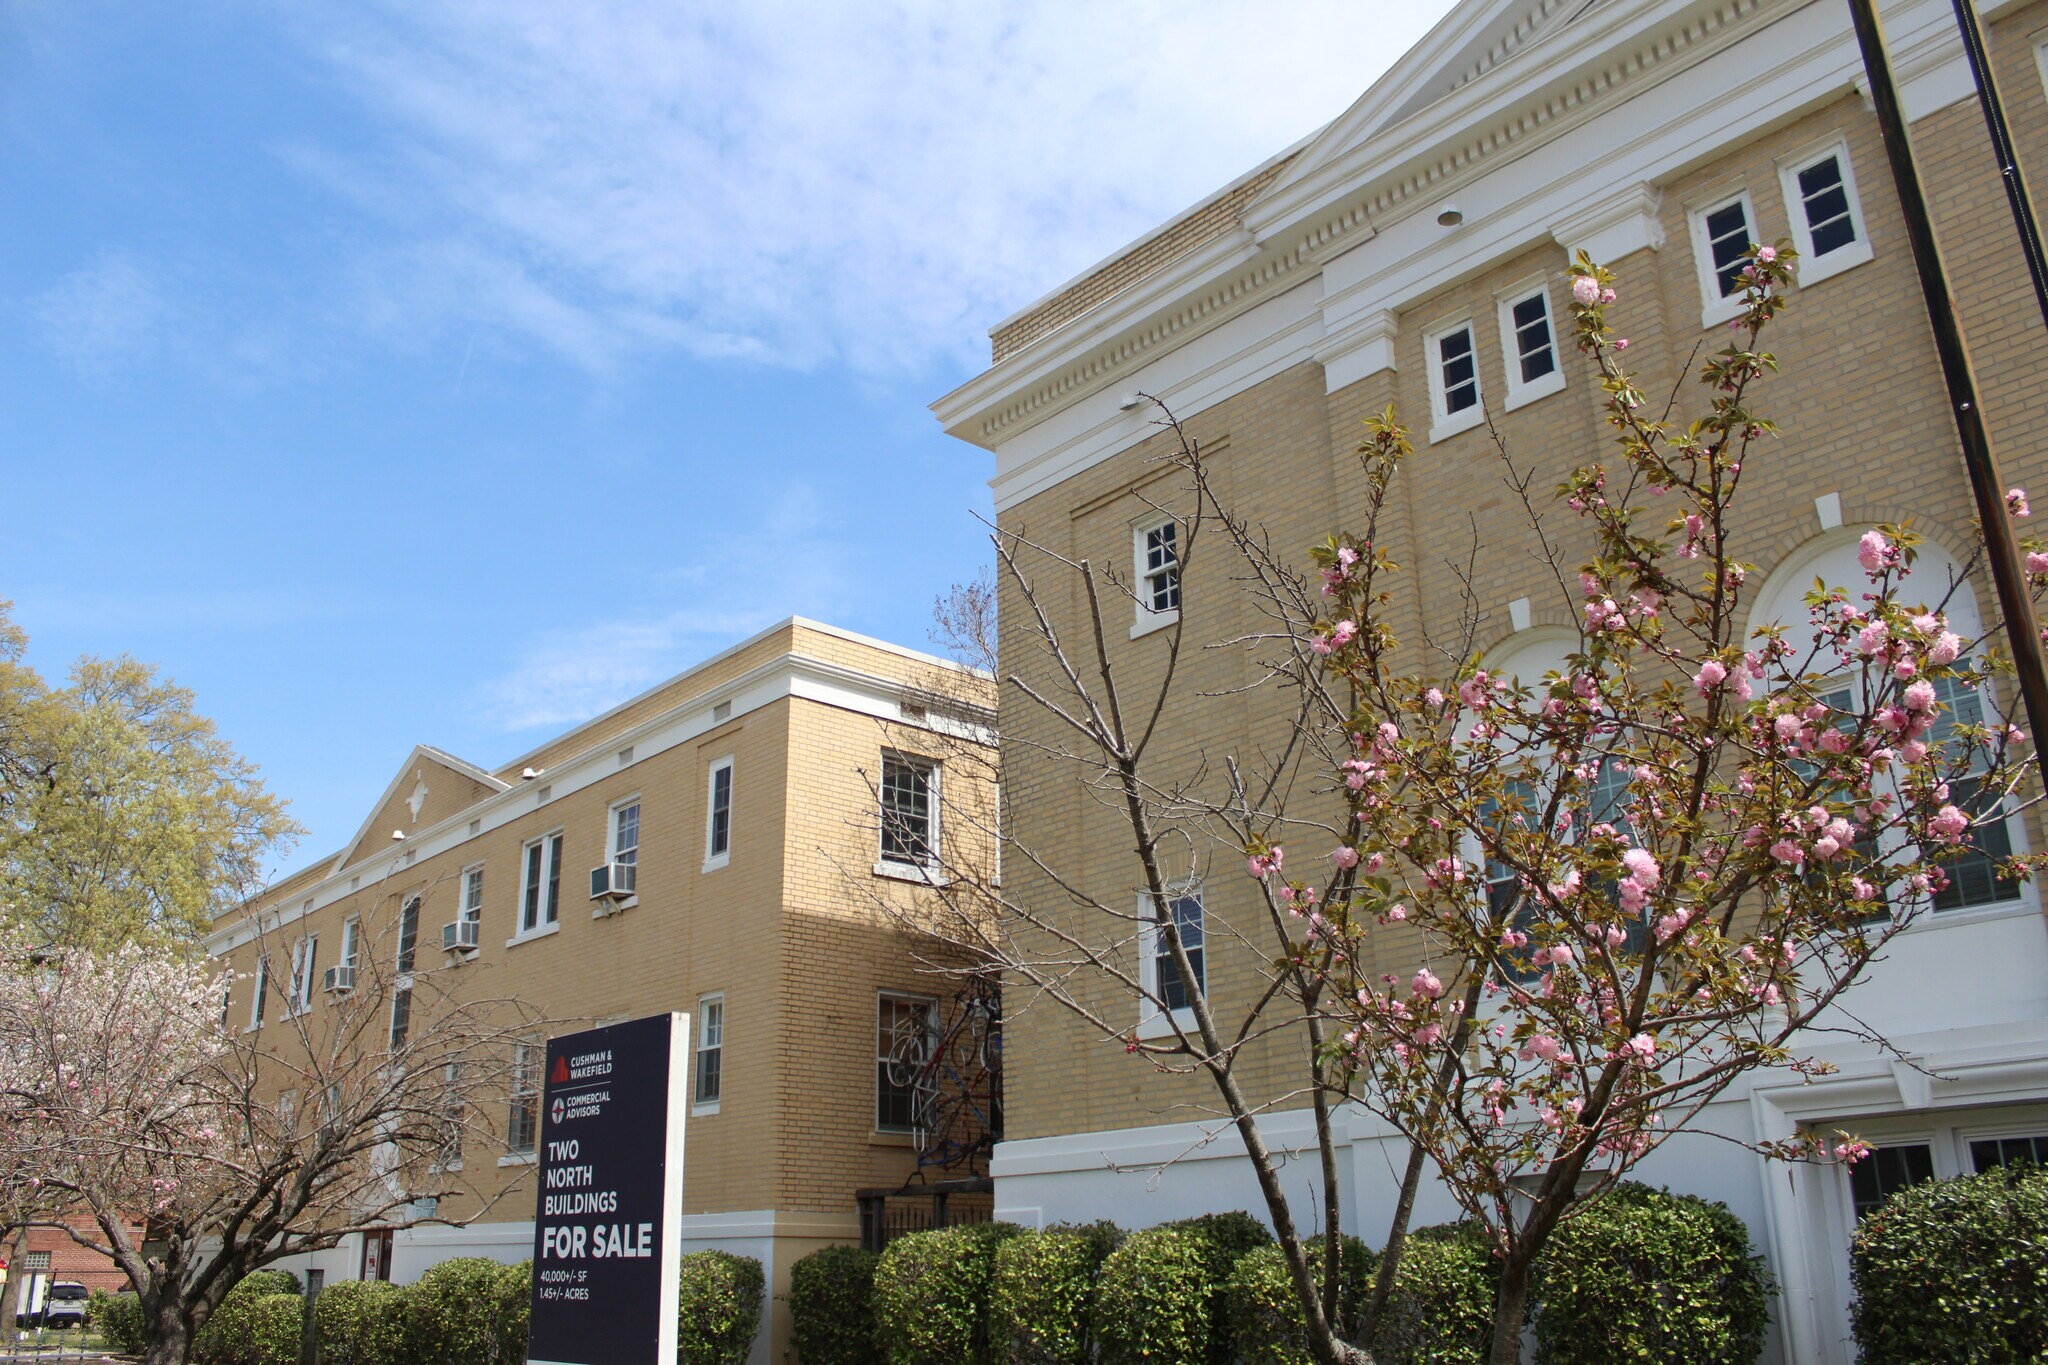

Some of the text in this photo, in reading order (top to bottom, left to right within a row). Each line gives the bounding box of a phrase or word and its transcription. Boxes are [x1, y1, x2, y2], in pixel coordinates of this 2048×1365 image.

[570, 1050, 613, 1067] CUSHMAN &
[570, 1062, 612, 1080] WAKEFIELD
[566, 1091, 610, 1107] COMMERCIAL
[566, 1105, 600, 1120] ADVISORS
[548, 1139, 579, 1162] TWO
[546, 1165, 593, 1189] NORTH
[545, 1191, 617, 1216] BUILDINGS
[542, 1223, 652, 1259] FOR SALE
[540, 1269, 587, 1284] 40,000+/- SF
[564, 1288, 589, 1300] ACRES
